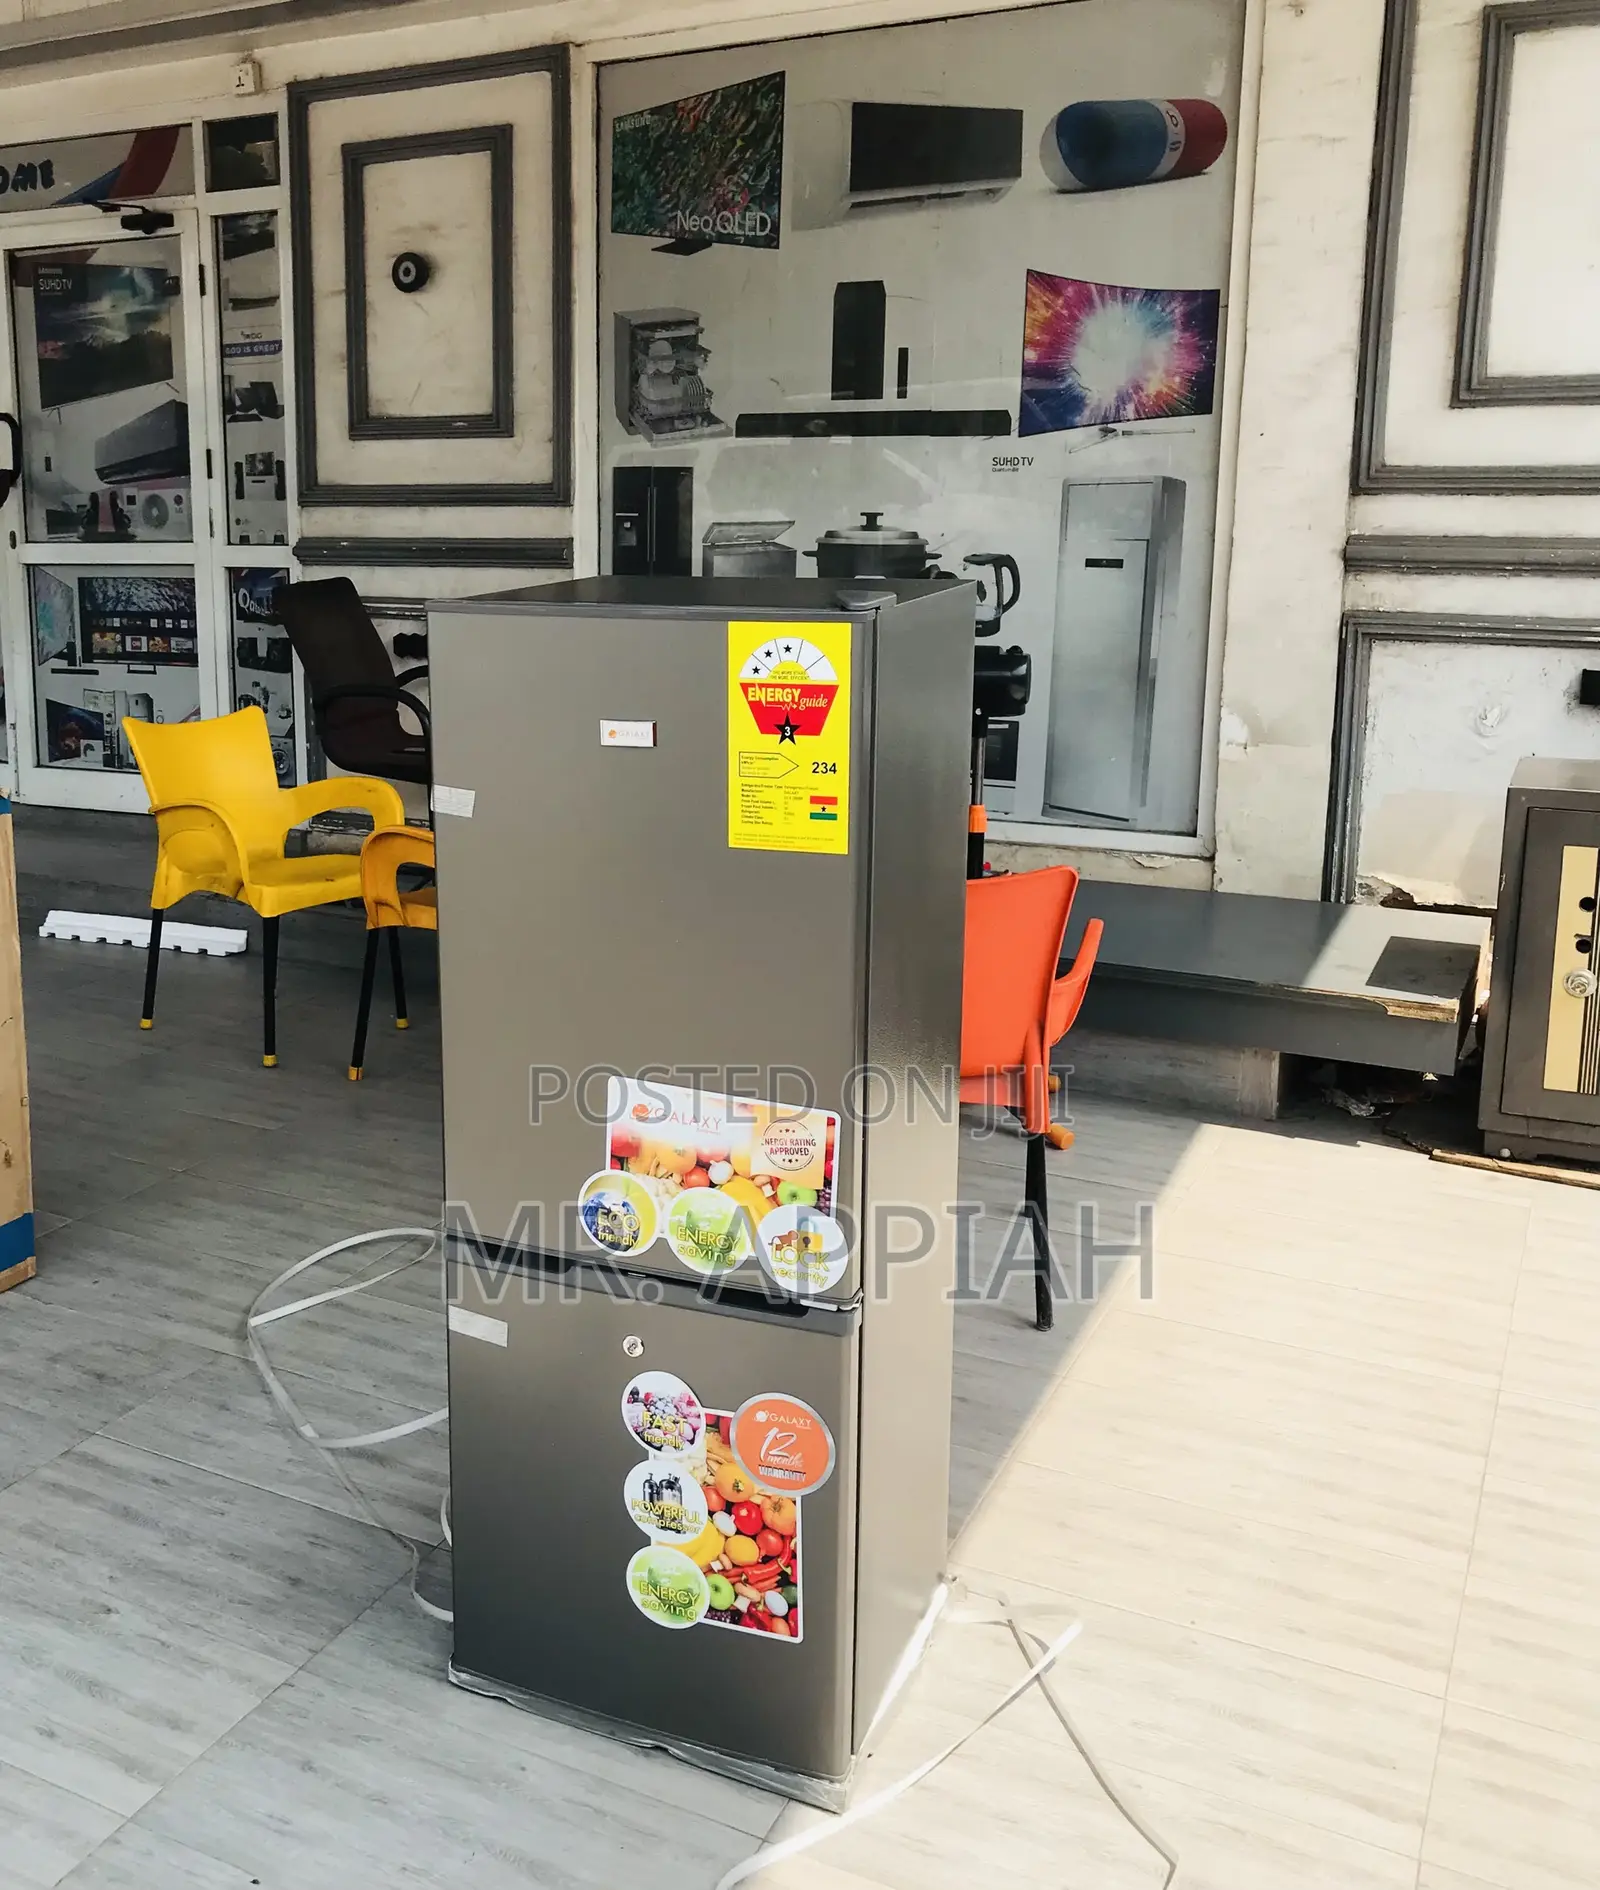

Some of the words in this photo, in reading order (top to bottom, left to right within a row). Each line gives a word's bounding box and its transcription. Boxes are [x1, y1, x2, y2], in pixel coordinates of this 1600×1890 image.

[676, 210, 713, 233] Neo
[716, 210, 771, 237] QLED
[747, 684, 801, 707] ENERGY
[799, 694, 828, 711] guide
[784, 726, 791, 736] 3
[811, 761, 838, 775] 234
[654, 1107, 722, 1131] GALAXY
[769, 1147, 810, 1156] APPROVED
[789, 1138, 817, 1147] RATING
[597, 1208, 641, 1232] ECO
[676, 1225, 741, 1252] ENERGY
[678, 1245, 736, 1267] saving
[771, 1244, 830, 1272] LOCK
[642, 1411, 688, 1436] FAST
[769, 1412, 812, 1427] GALAXY
[643, 1431, 685, 1451] friendly
[759, 1426, 797, 1463] 12
[758, 1464, 807, 1483] WARRANTY
[631, 1498, 703, 1525] POWERFUL
[634, 1513, 702, 1535] compressor
[640, 1580, 700, 1607] ENERGY
[641, 1598, 697, 1622] saving
